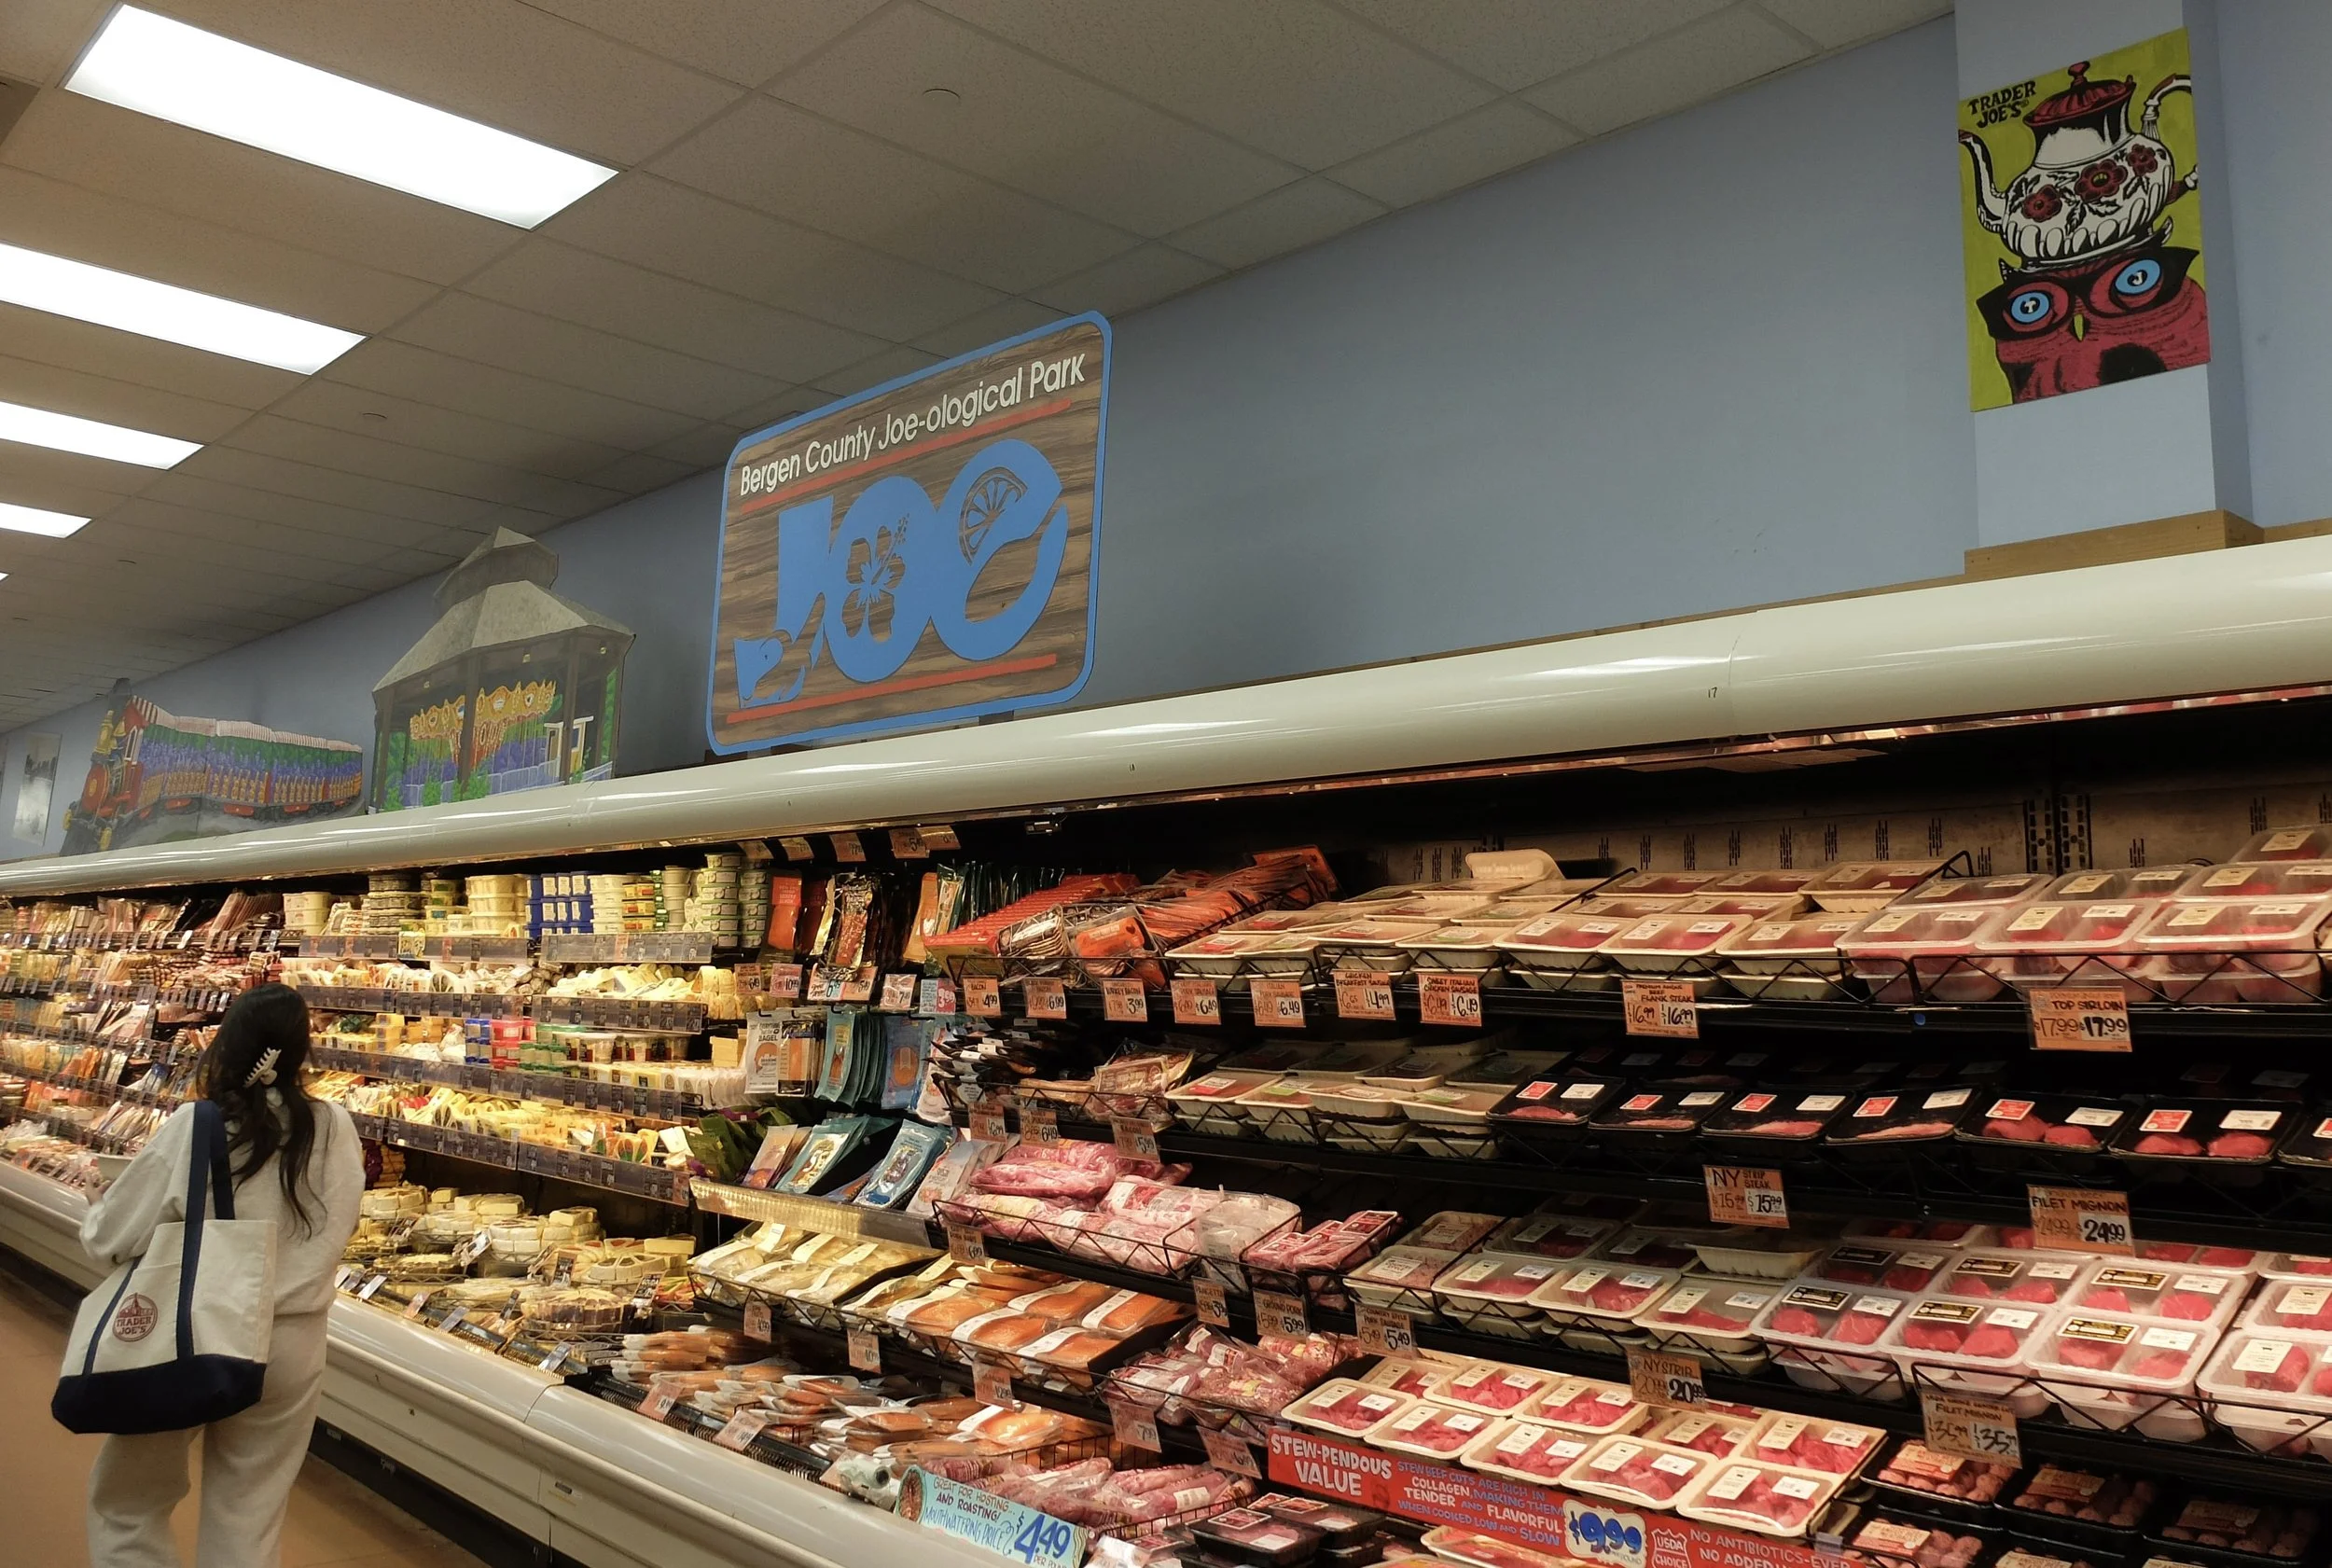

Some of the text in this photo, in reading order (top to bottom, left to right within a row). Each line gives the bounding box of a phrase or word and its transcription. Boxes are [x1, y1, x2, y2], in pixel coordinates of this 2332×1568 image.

[1967, 81, 2036, 115] TRADER
[740, 354, 1086, 496] Bergen County Joe-ological Park
[1427, 977, 1447, 985] SWEET
[2052, 1000, 2124, 1011] TOP SIRLOIN
[2034, 1016, 2128, 1036] $17.99 $17.99
[1712, 1169, 1741, 1186] NY
[1744, 1180, 1771, 1188] STEAK
[2032, 1196, 2127, 1213] FILET MIGNON
[1287, 1305, 1303, 1316] PORK
[117, 1316, 151, 1327] TRADER
[118, 1325, 147, 1335] JOE'S
[1644, 1358, 1693, 1377] NY STRIP
[1936, 1403, 2002, 1421] FILET MIGNON
[1270, 1434, 1393, 1479] STEW-PENDOUS
[1295, 1460, 1362, 1496] VALUE
[1397, 1461, 1546, 1502] STEW BEEF CUTS ARE RICH IN
[933, 1478, 956, 1492] GREAT
[958, 1484, 974, 1499] FOR
[1411, 1477, 1564, 1518] COLLAGEN, MAKING THEM
[936, 1492, 1002, 1522] AND ROASTING!
[1404, 1486, 1563, 1534] TENDER AND FLAVORFUL
[923, 1506, 1006, 1551] MOUTHWATERING PRICE
[1397, 1500, 1561, 1547] WHEN COOKED LOW AND SLOW
[1569, 1511, 1642, 1555] $9.99
[1014, 1510, 1071, 1564] $4.49
[1657, 1536, 1684, 1550] USDA
[1690, 1529, 1711, 1543] NO
[1034, 1555, 1047, 1567] PER
[1655, 1554, 1688, 1568] CHOICE
[1700, 1547, 1720, 1561] NO
